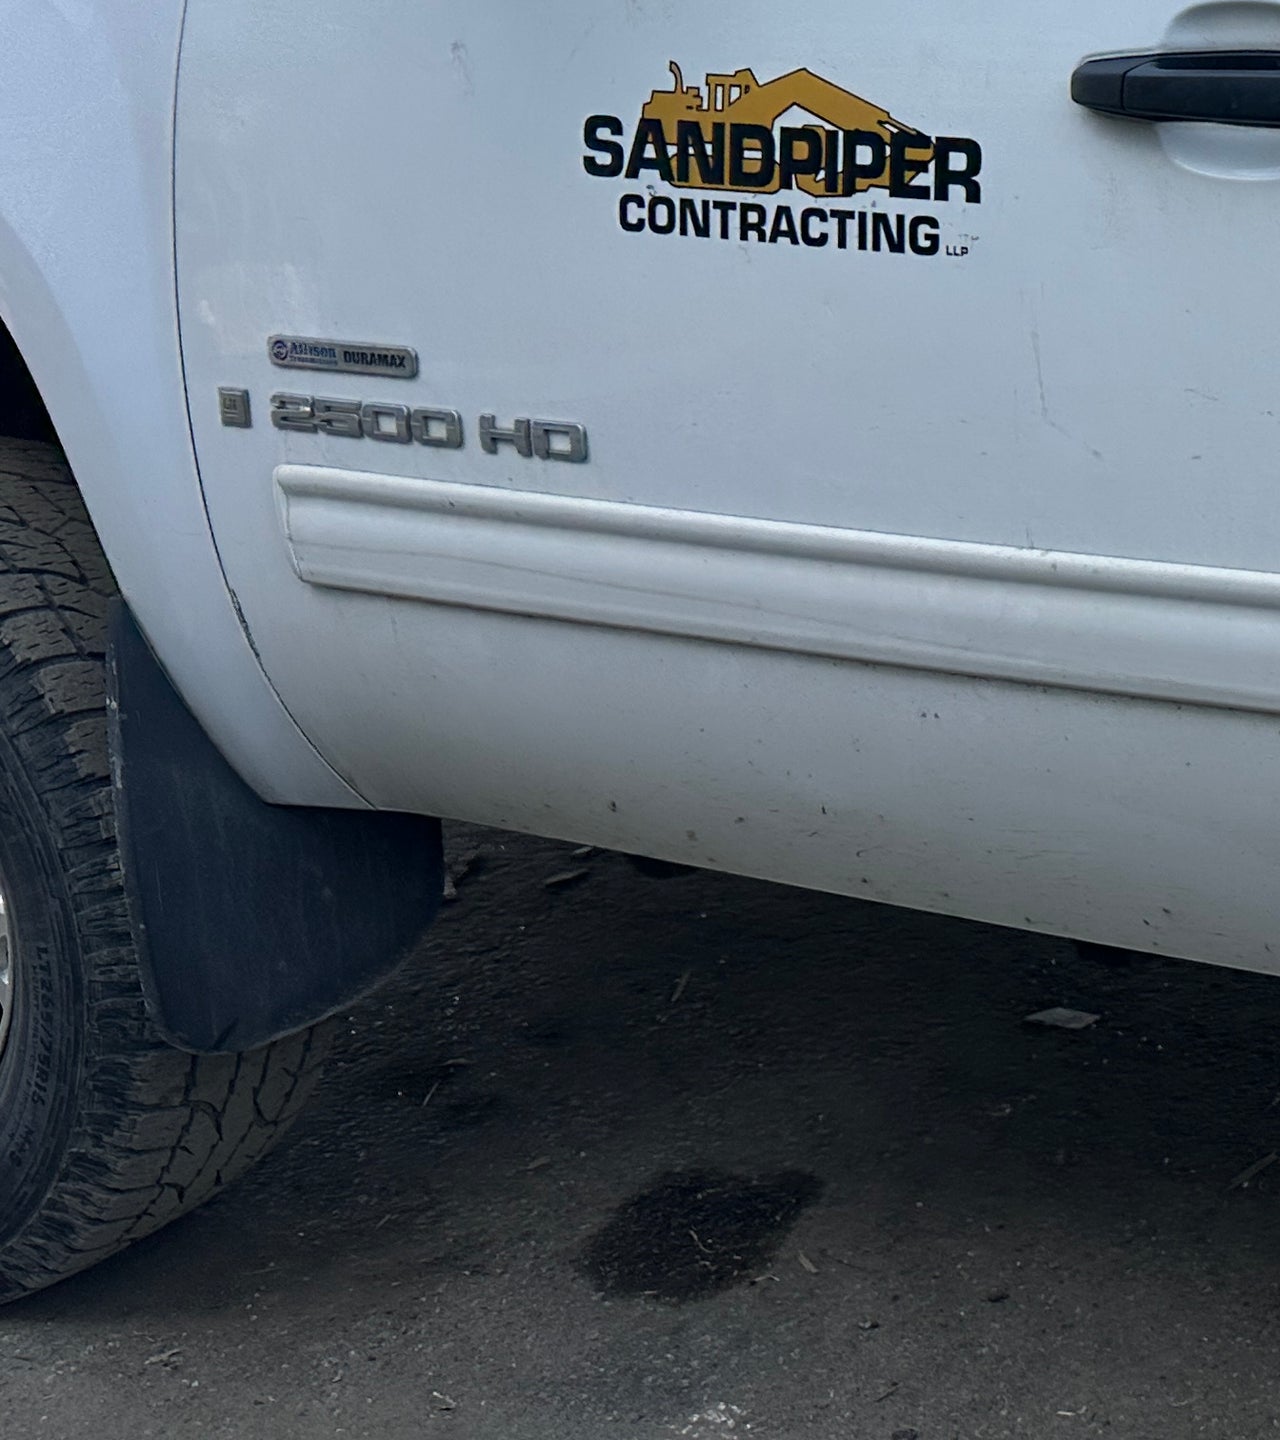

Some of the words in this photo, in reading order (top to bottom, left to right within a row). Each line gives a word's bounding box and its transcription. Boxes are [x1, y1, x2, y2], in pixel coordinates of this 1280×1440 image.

[582, 114, 982, 204] SANDPIPER
[618, 193, 941, 257] CONTRACTING
[945, 244, 970, 258] LLP
[289, 341, 338, 358] Allison
[343, 350, 406, 368] DURAMAX
[270, 391, 465, 450] 2500
[478, 412, 589, 463] HD
